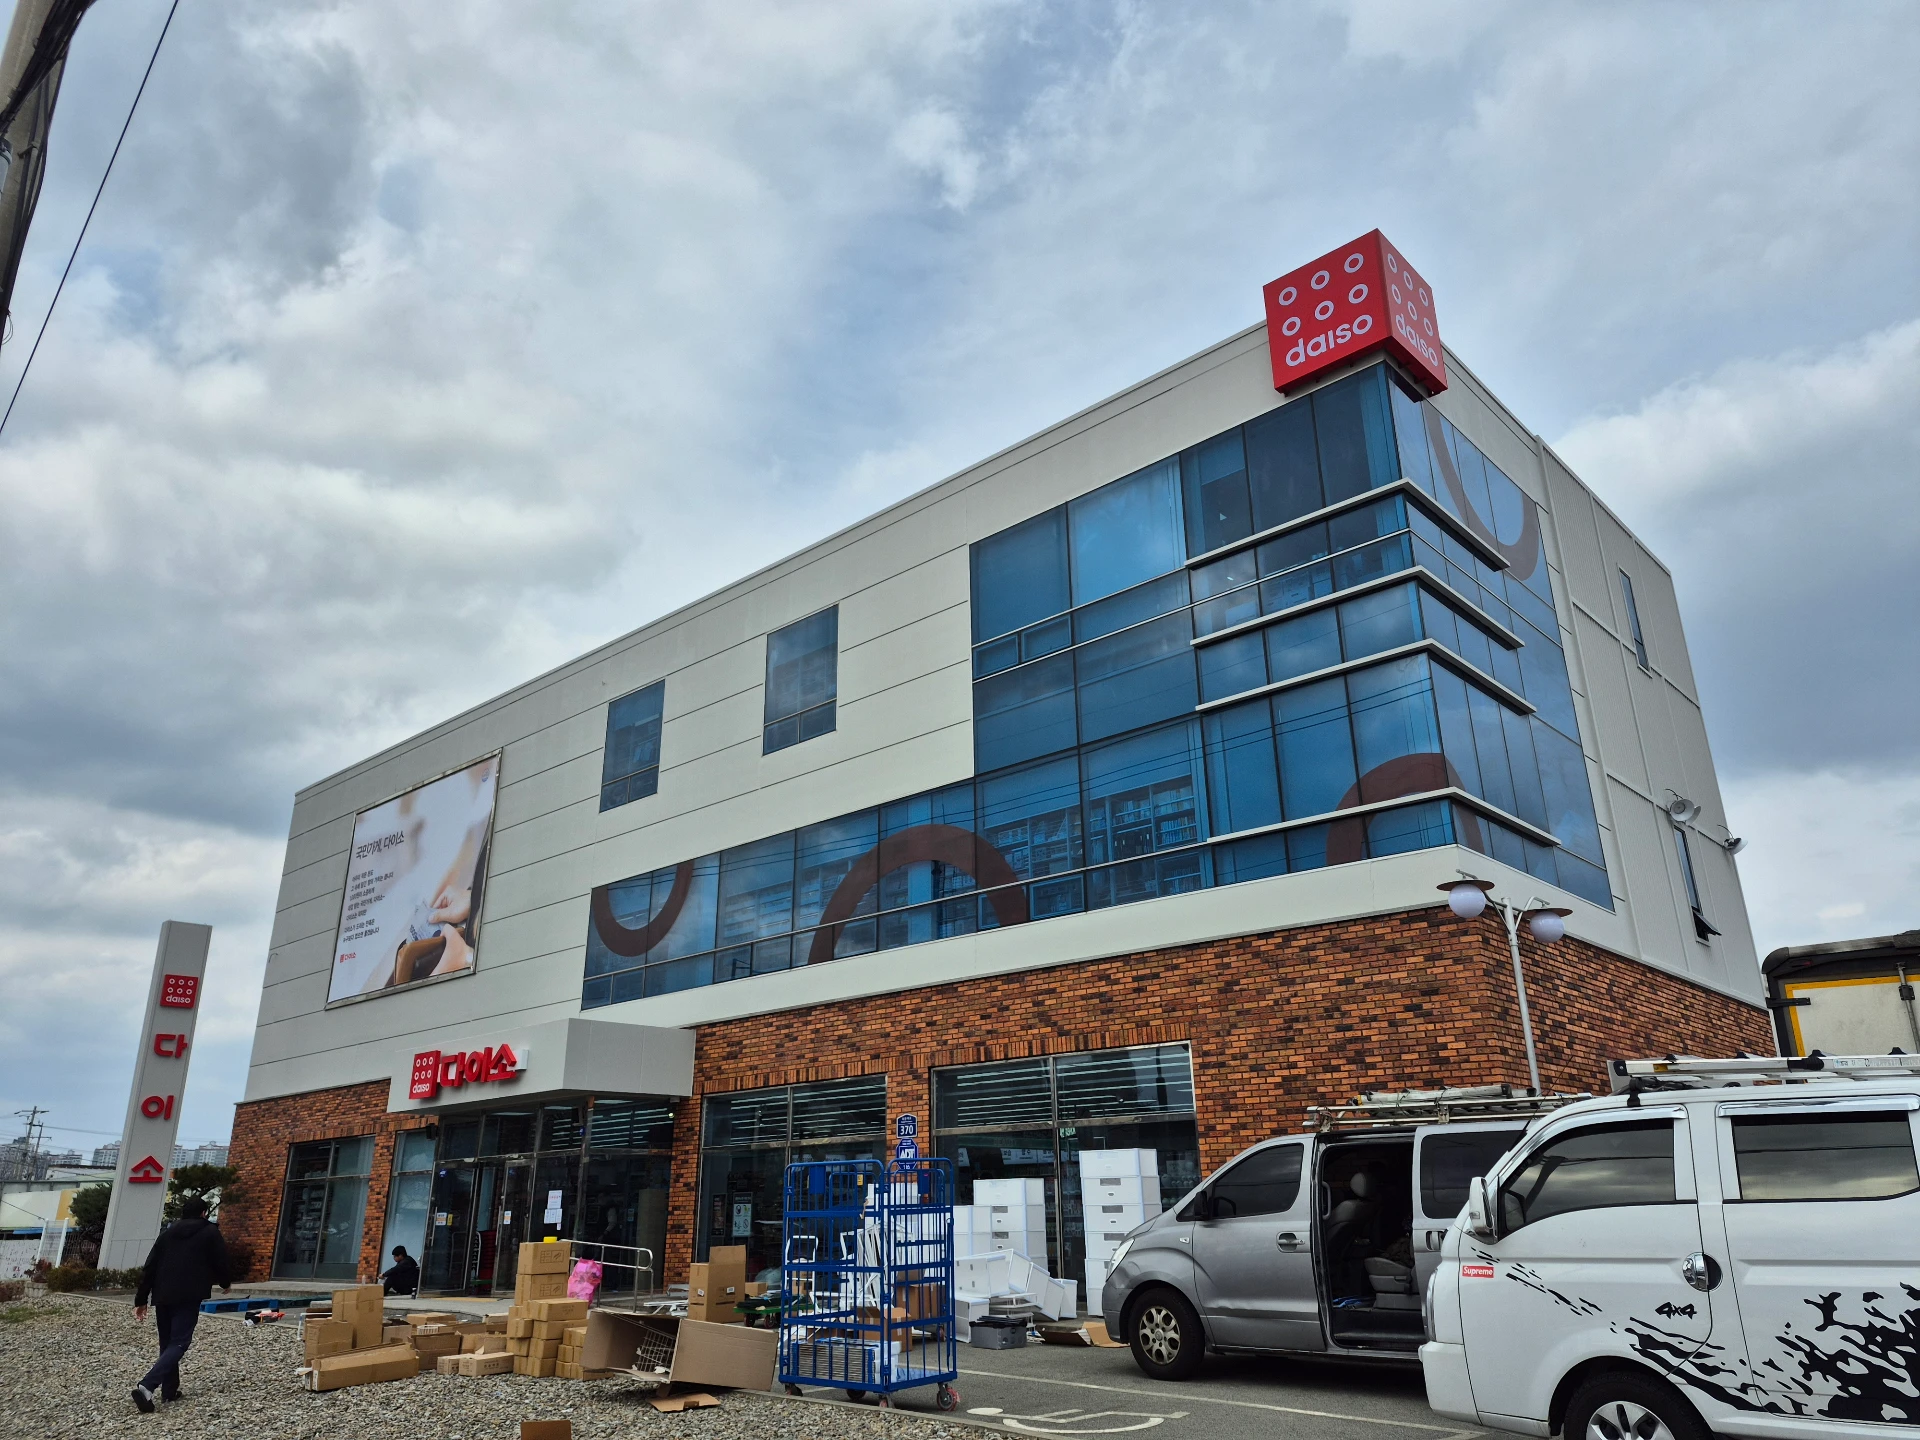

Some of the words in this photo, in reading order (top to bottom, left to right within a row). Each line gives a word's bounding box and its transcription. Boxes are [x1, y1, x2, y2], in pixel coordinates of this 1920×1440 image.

[1285, 314, 1373, 367] daiso
[1395, 313, 1438, 367] daiso
[383, 830, 405, 849] 다이소
[165, 994, 191, 1004] daiso
[440, 1043, 517, 1088] 다이소
[412, 1082, 430, 1094] daiso
[900, 1124, 914, 1136] 370
[900, 1148, 915, 1159] ADT
[1463, 1266, 1493, 1277] Supreme
